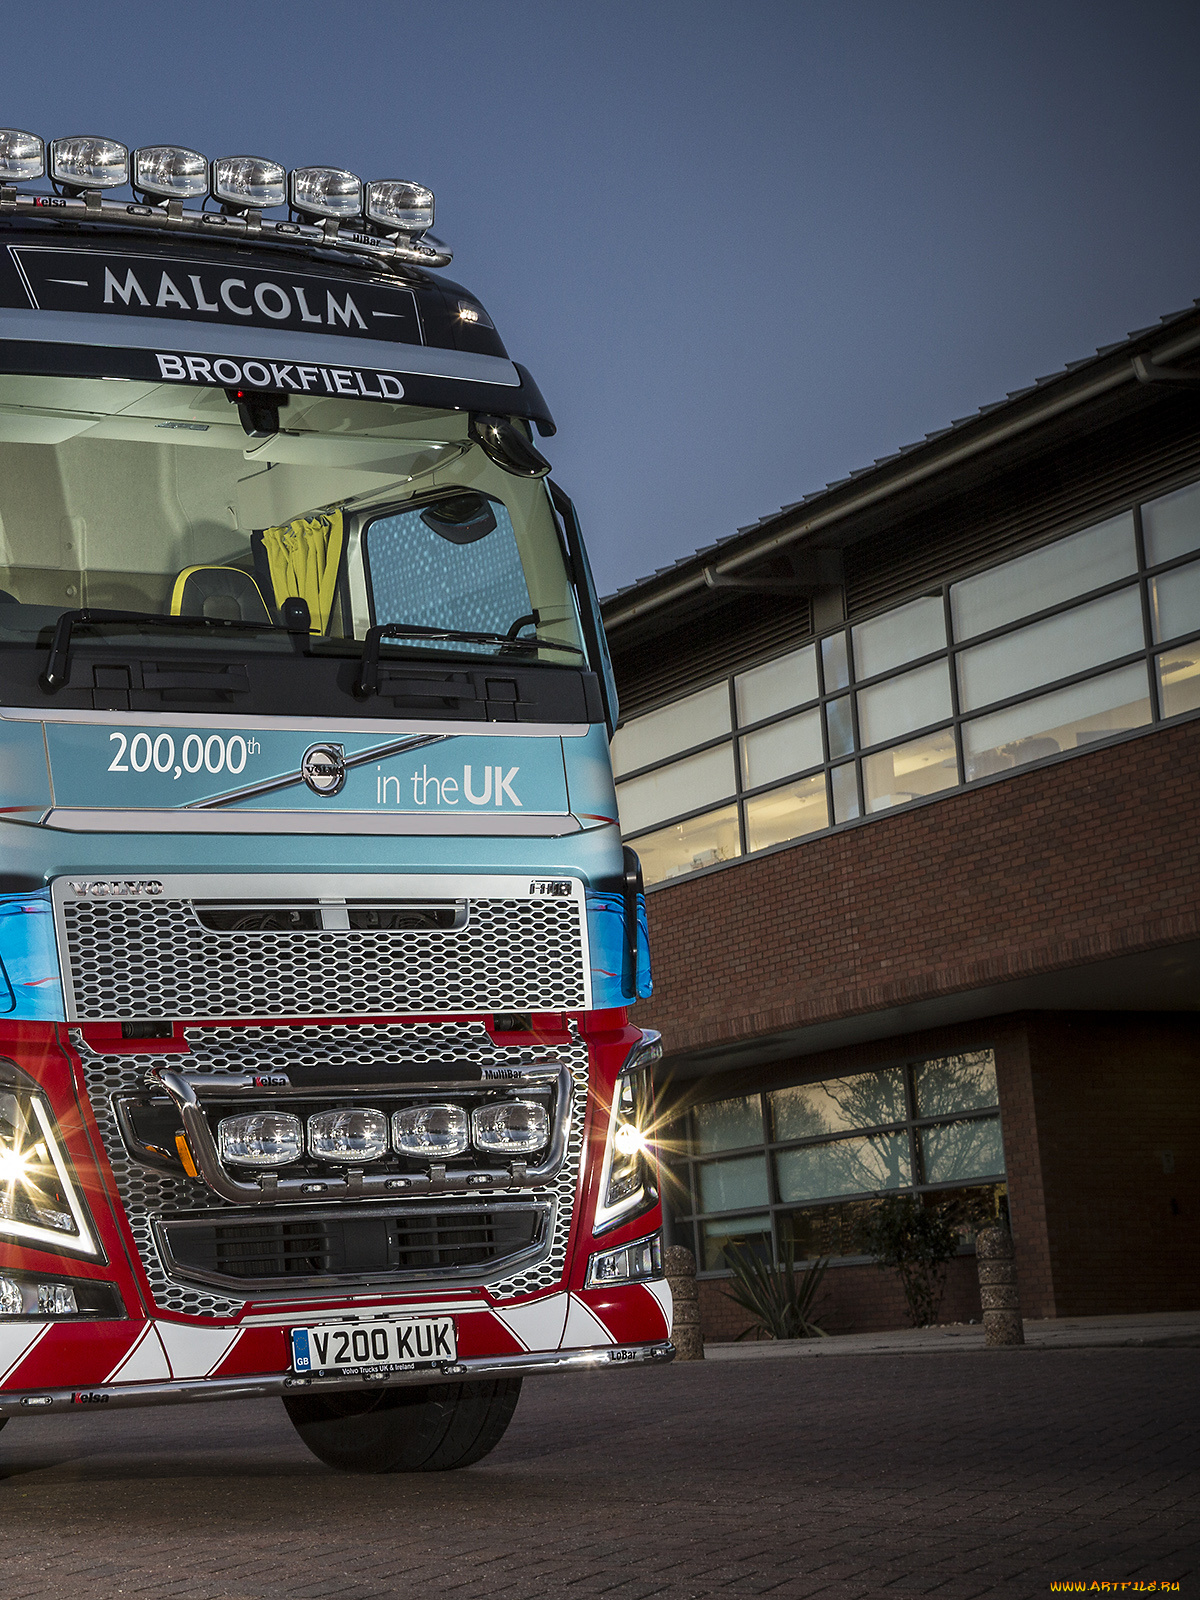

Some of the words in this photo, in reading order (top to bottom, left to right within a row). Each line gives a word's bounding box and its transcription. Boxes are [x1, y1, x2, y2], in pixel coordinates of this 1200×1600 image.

[32, 197, 67, 207] Kelsa
[103, 266, 369, 330] MALCOLM
[155, 353, 406, 400] BROOKFIELD
[305, 766, 341, 774] VOLVO
[376, 765, 401, 804] in
[413, 767, 459, 805] the
[464, 766, 523, 806] UK
[68, 880, 165, 898] VOLVO
[484, 1069, 523, 1081] MultiBar
[252, 1076, 286, 1087] Kelsa
[313, 1329, 389, 1365] V200
[396, 1323, 452, 1359] KUK
[611, 1350, 637, 1360] LoBar
[297, 1356, 309, 1367] GB
[342, 1366, 358, 1375] Volvo
[359, 1365, 379, 1374] Trucks
[379, 1364, 388, 1372] UK
[389, 1363, 394, 1371] &
[70, 1391, 110, 1405] Kelsa
